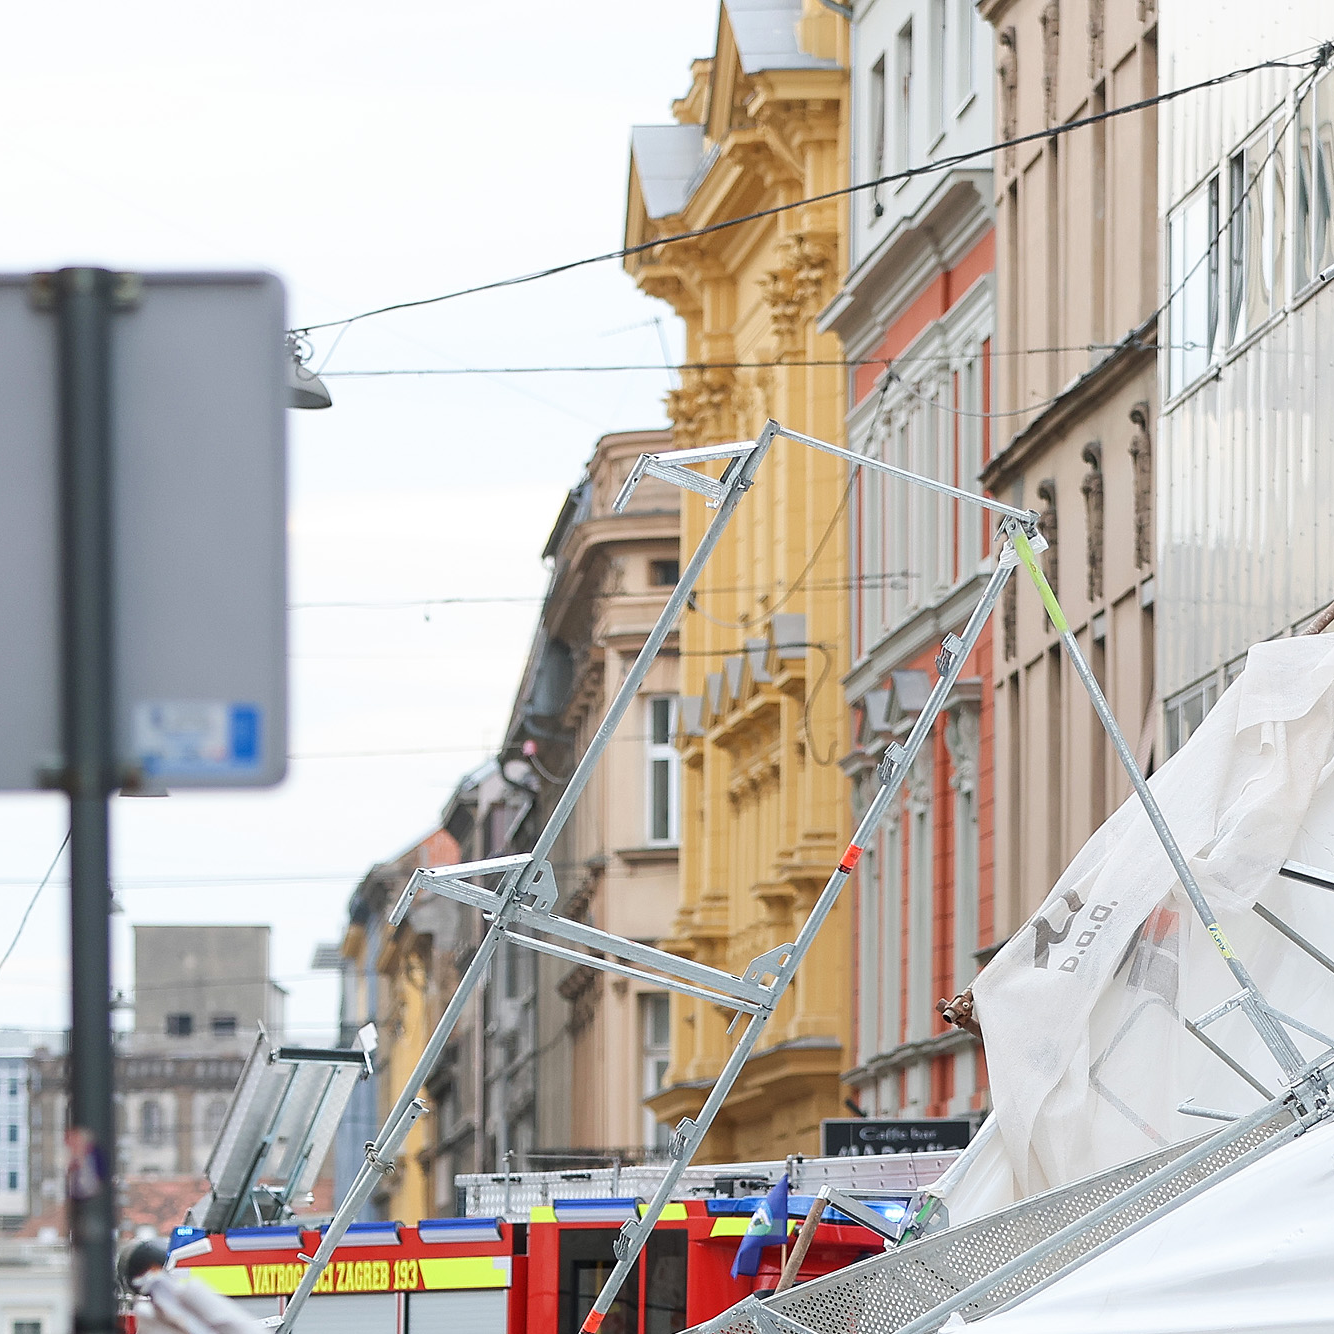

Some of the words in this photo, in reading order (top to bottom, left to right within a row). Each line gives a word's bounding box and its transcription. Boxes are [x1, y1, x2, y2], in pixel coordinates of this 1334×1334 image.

[252, 1261, 334, 1294] VATROGCI
[336, 1259, 391, 1292] ZAGREB
[393, 1258, 419, 1290] 193
